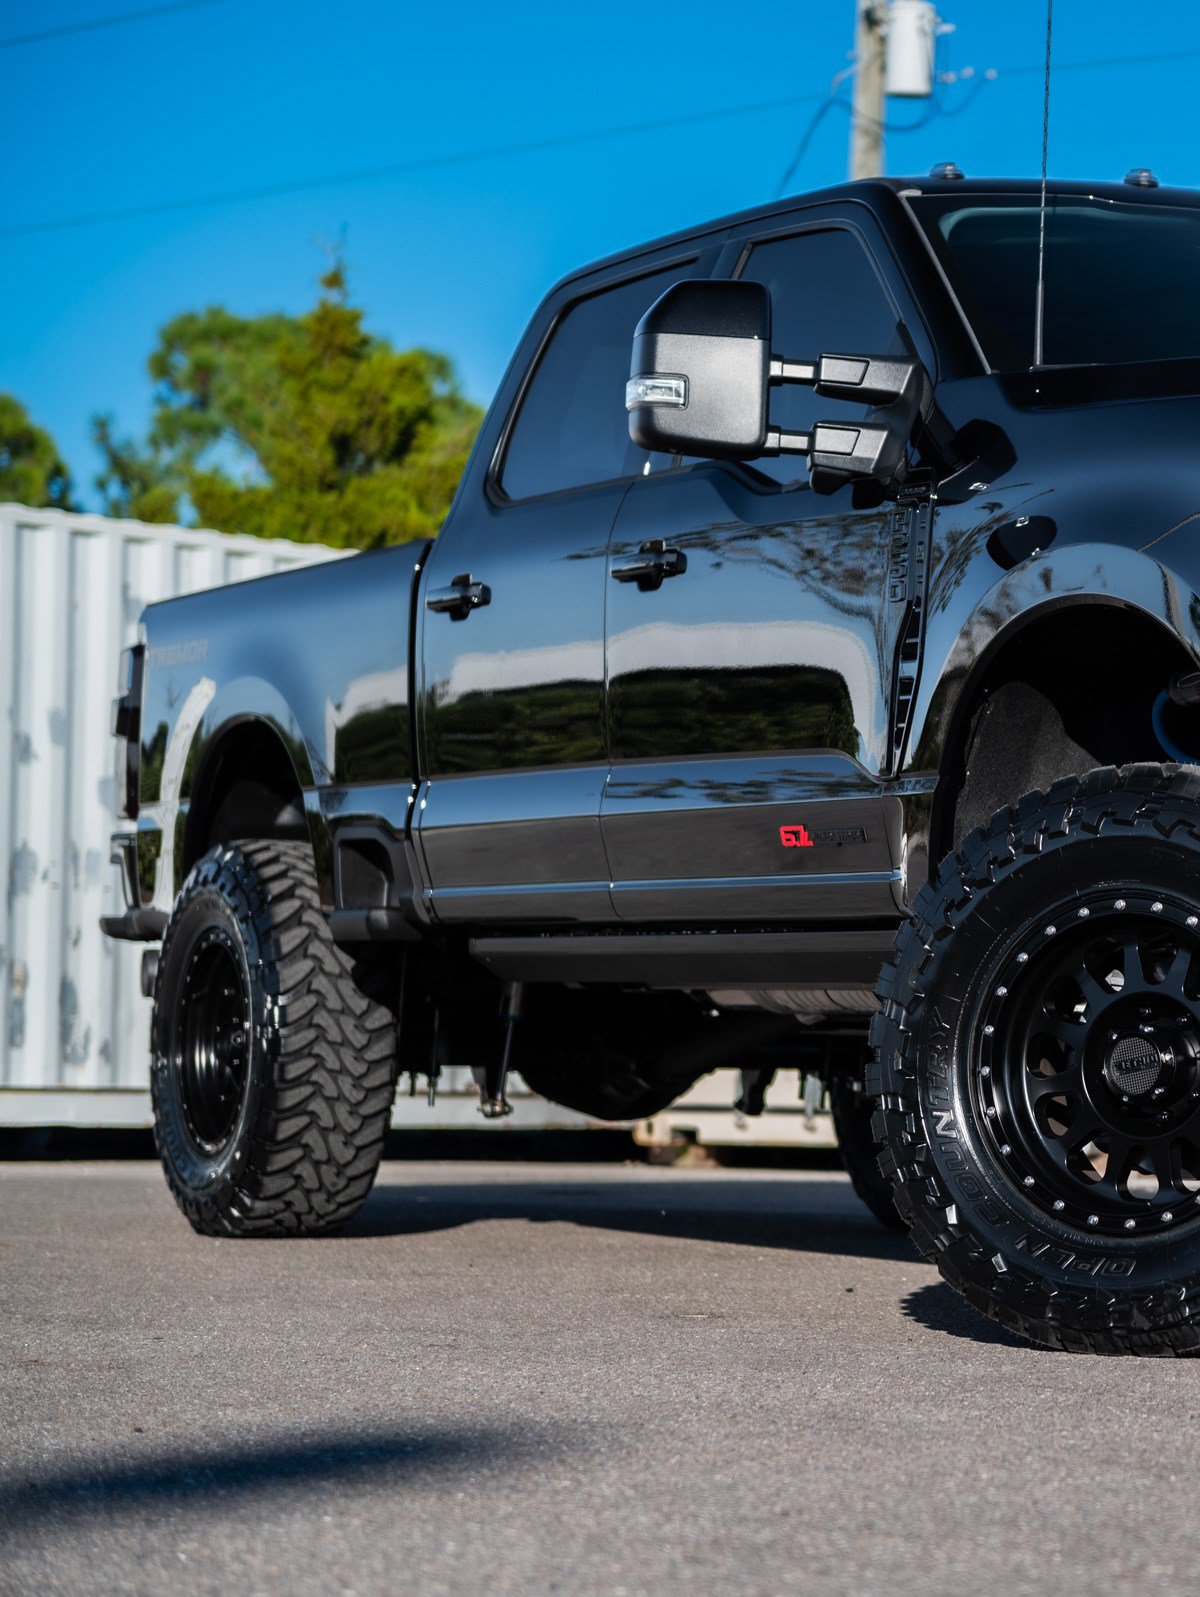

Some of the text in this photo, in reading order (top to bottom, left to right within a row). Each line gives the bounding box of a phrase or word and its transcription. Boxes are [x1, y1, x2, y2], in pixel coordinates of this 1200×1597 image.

[148, 638, 210, 668] TREMOR
[928, 1006, 1010, 1228] COUNTRY
[1014, 1233, 1137, 1277] OPEN
